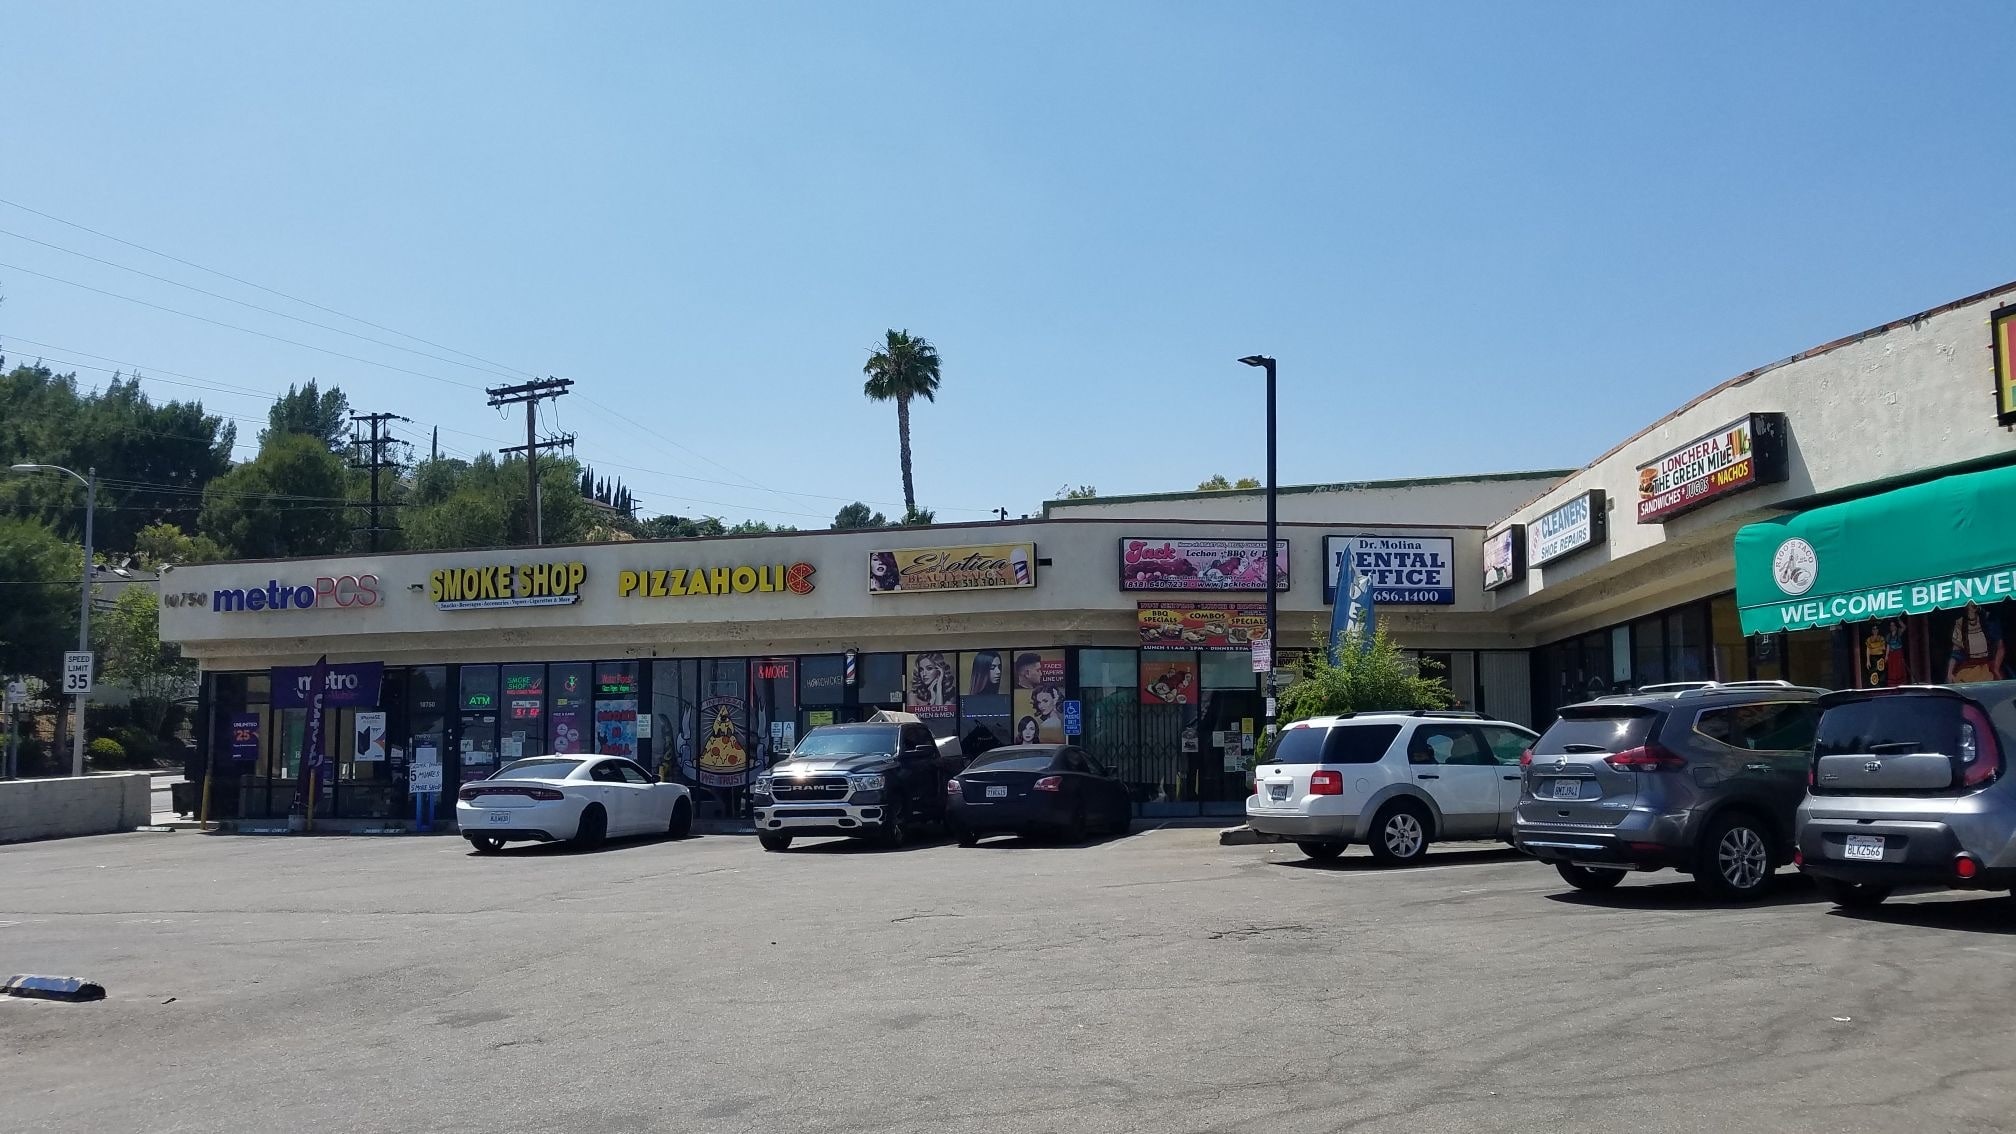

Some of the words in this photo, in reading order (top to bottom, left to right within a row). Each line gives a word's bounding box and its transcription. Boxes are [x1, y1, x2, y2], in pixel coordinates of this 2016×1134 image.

[1661, 438, 1720, 474] LONCHERA
[1653, 475, 1671, 495] THE
[1673, 458, 1705, 485] GREEN
[1707, 446, 1733, 474] MILE
[1640, 488, 1681, 516] SANDWICHES
[1685, 477, 1710, 500] JUGOS
[1717, 461, 1749, 487] NACHOS
[1541, 498, 1588, 539] CLEANERS
[1359, 540, 1377, 549] Dr.
[1379, 540, 1422, 550] Molina
[1541, 544, 1558, 560] SHOE
[1559, 527, 1587, 552] REPAIRS
[1125, 540, 1176, 564] Jack
[1185, 549, 1217, 557] Lechon
[1227, 549, 1246, 559] BBQ
[1797, 541, 1815, 564] TACO
[430, 565, 513, 602] SMOKE
[517, 560, 586, 597] SHOP
[618, 562, 816, 598] PIZZAHOLIC
[908, 573, 956, 583] BEAUTY
[1125, 581, 1147, 589] (818)
[1167, 580, 1188, 588] 7239
[213, 574, 379, 612] metroPCS
[1373, 590, 1439, 602] 686.1400
[1780, 589, 1904, 625] WELCOME
[1911, 570, 2016, 607] BIENVE
[1143, 616, 1178, 624] SPECIALS
[1231, 616, 1268, 625] SPECIALS
[68, 655, 90, 663] SPEED
[765, 664, 789, 679] MORE
[68, 674, 88, 690] 35
[507, 676, 531, 684] SMOKE
[468, 696, 490, 705] ATM
[410, 770, 417, 782] 5
[701, 772, 715, 785] WE
[720, 774, 744, 786] TRUST
[1847, 844, 1881, 857] 8LKZ566
